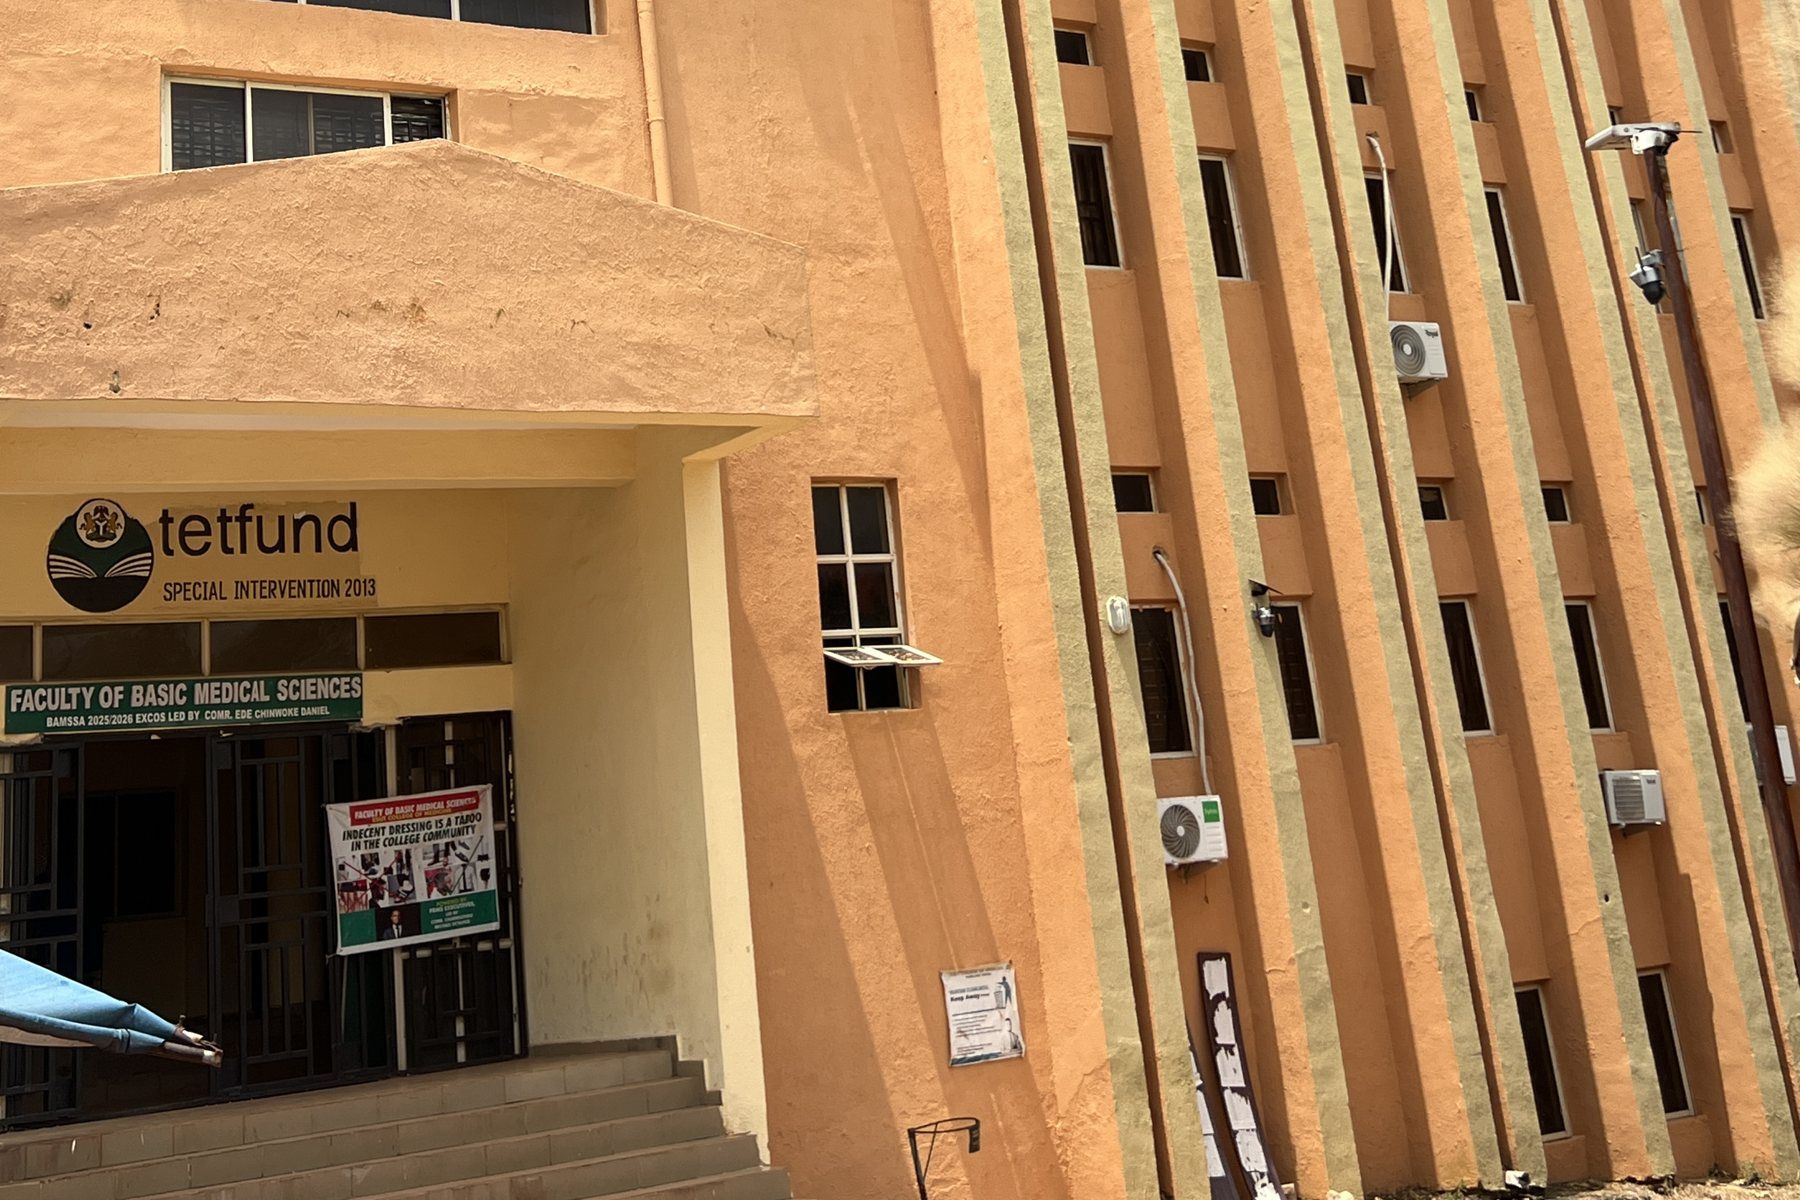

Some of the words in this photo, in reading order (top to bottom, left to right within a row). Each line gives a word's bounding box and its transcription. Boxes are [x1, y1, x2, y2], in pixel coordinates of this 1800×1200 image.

[159, 502, 358, 557] tetfund
[162, 580, 228, 602] SPECIAL
[234, 578, 340, 600] INTERVENTION
[344, 577, 376, 598] 2013
[10, 686, 95, 712] FACULTY
[98, 685, 124, 709] OF
[130, 682, 187, 708] BASIC
[194, 680, 270, 705] MEDICAL
[276, 676, 362, 702] SCIENCES
[46, 716, 86, 728] BAMSSA
[88, 714, 133, 726] 2025/2026
[136, 712, 166, 724] EXCOS
[168, 711, 184, 722] LED
[188, 710, 200, 720] BY
[204, 710, 233, 720] COMR.
[235, 708, 252, 720] EDE
[254, 707, 299, 718] CHINWOKE
[301, 706, 330, 716] DANIEL
[354, 808, 384, 820] FACULTY
[384, 807, 394, 816] OF
[395, 804, 415, 814] BASIC
[416, 800, 444, 811] MEDICAL
[342, 826, 386, 841] INDECENT
[388, 820, 432, 836] DRESSING
[435, 818, 444, 828] IS
[446, 818, 452, 826] A
[454, 812, 482, 826] TABOO
[351, 840, 361, 852] IN
[364, 838, 380, 850] THE
[382, 834, 420, 848] COLLEGE
[422, 824, 476, 842] COMMUNITY
